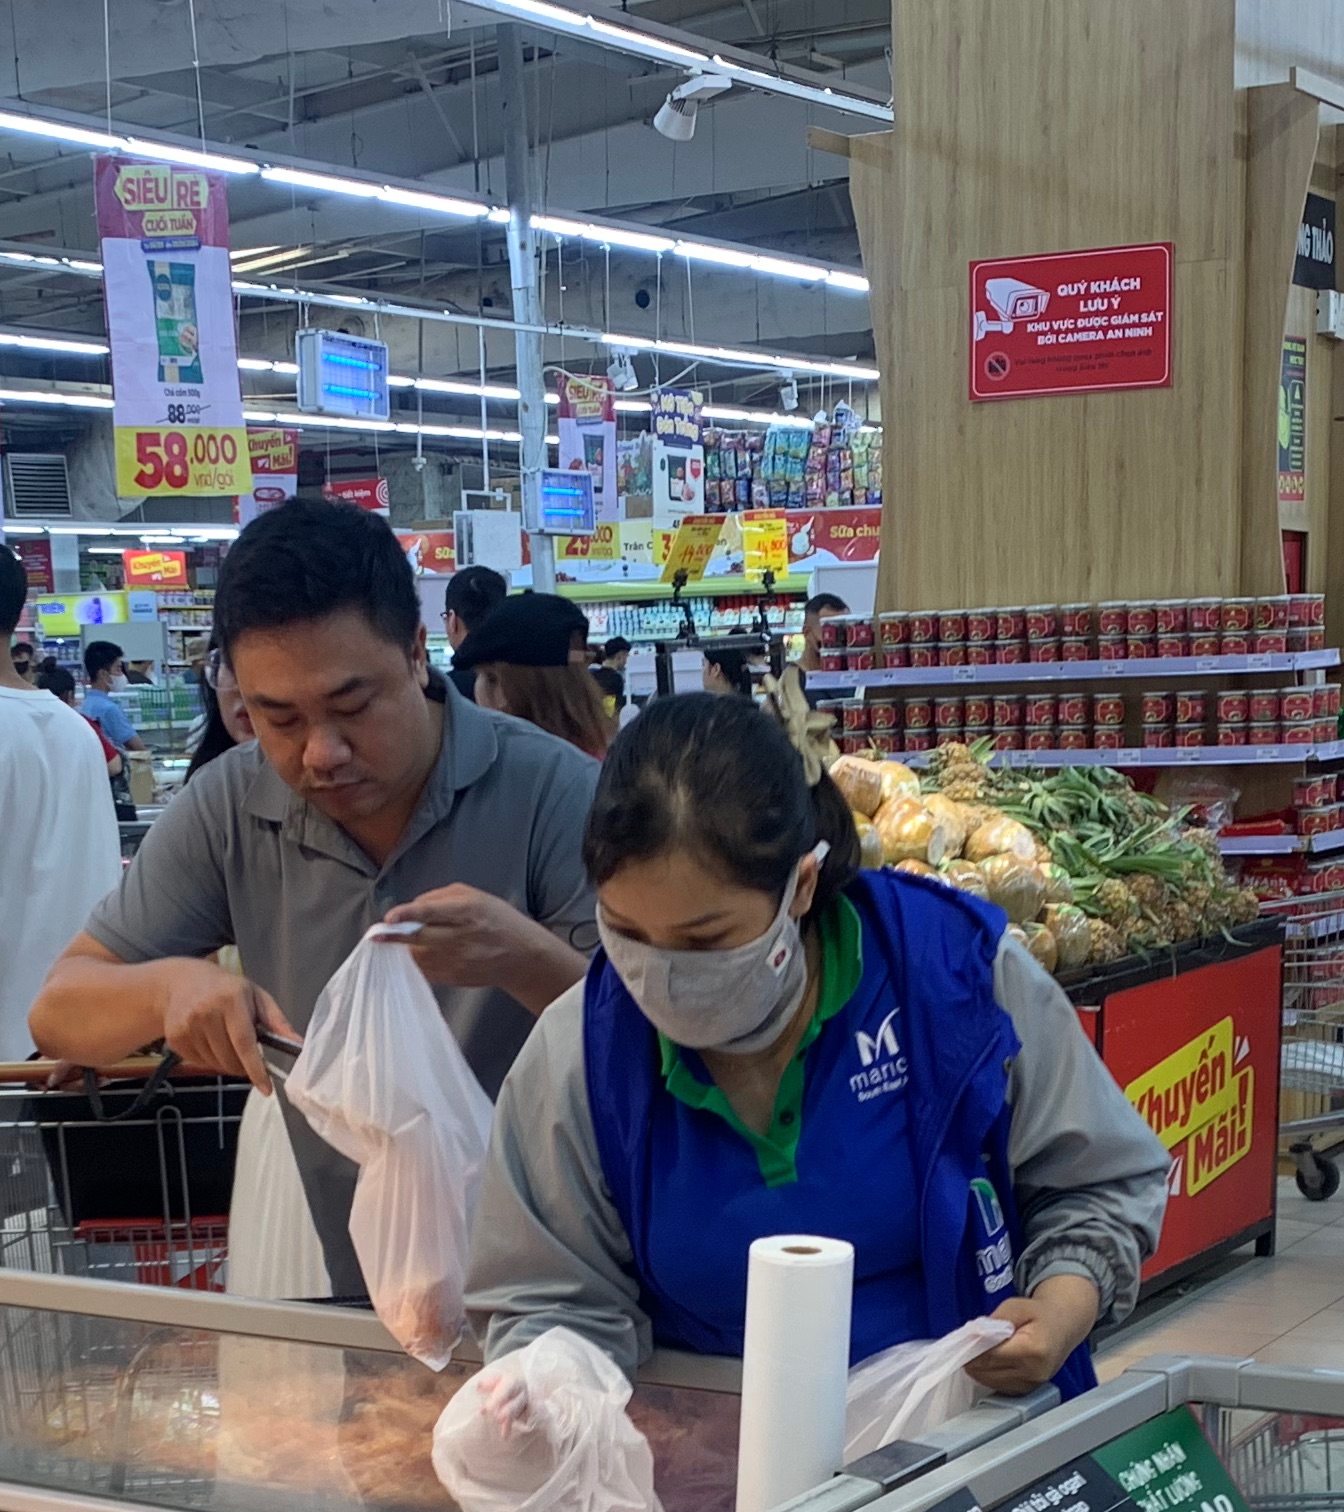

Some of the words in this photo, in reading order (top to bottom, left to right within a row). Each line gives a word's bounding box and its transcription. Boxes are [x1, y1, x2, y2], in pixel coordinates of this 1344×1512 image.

[123, 169, 167, 206] SIÊU
[177, 178, 201, 207] RẺ
[1312, 218, 1334, 265] THẢO
[1057, 279, 1087, 296] QUÝ
[1090, 276, 1141, 295] KHÁCH
[1079, 297, 1108, 312] LƯU
[1111, 296, 1121, 310] Ý
[1027, 320, 1050, 332] KHU
[1052, 317, 1076, 332] VỰC
[1077, 315, 1108, 330] ĐƯỢC
[1110, 311, 1140, 325] GIÁM
[1141, 310, 1163, 323] SÁT
[1058, 329, 1104, 344] CAMERA
[1106, 328, 1123, 339] AN
[1125, 326, 1152, 338] NINH
[134, 431, 238, 490] 58.000
[830, 525, 854, 539] Sữa
[855, 523, 881, 537] chu
[1192, 1077, 1249, 1186] Mãi!
